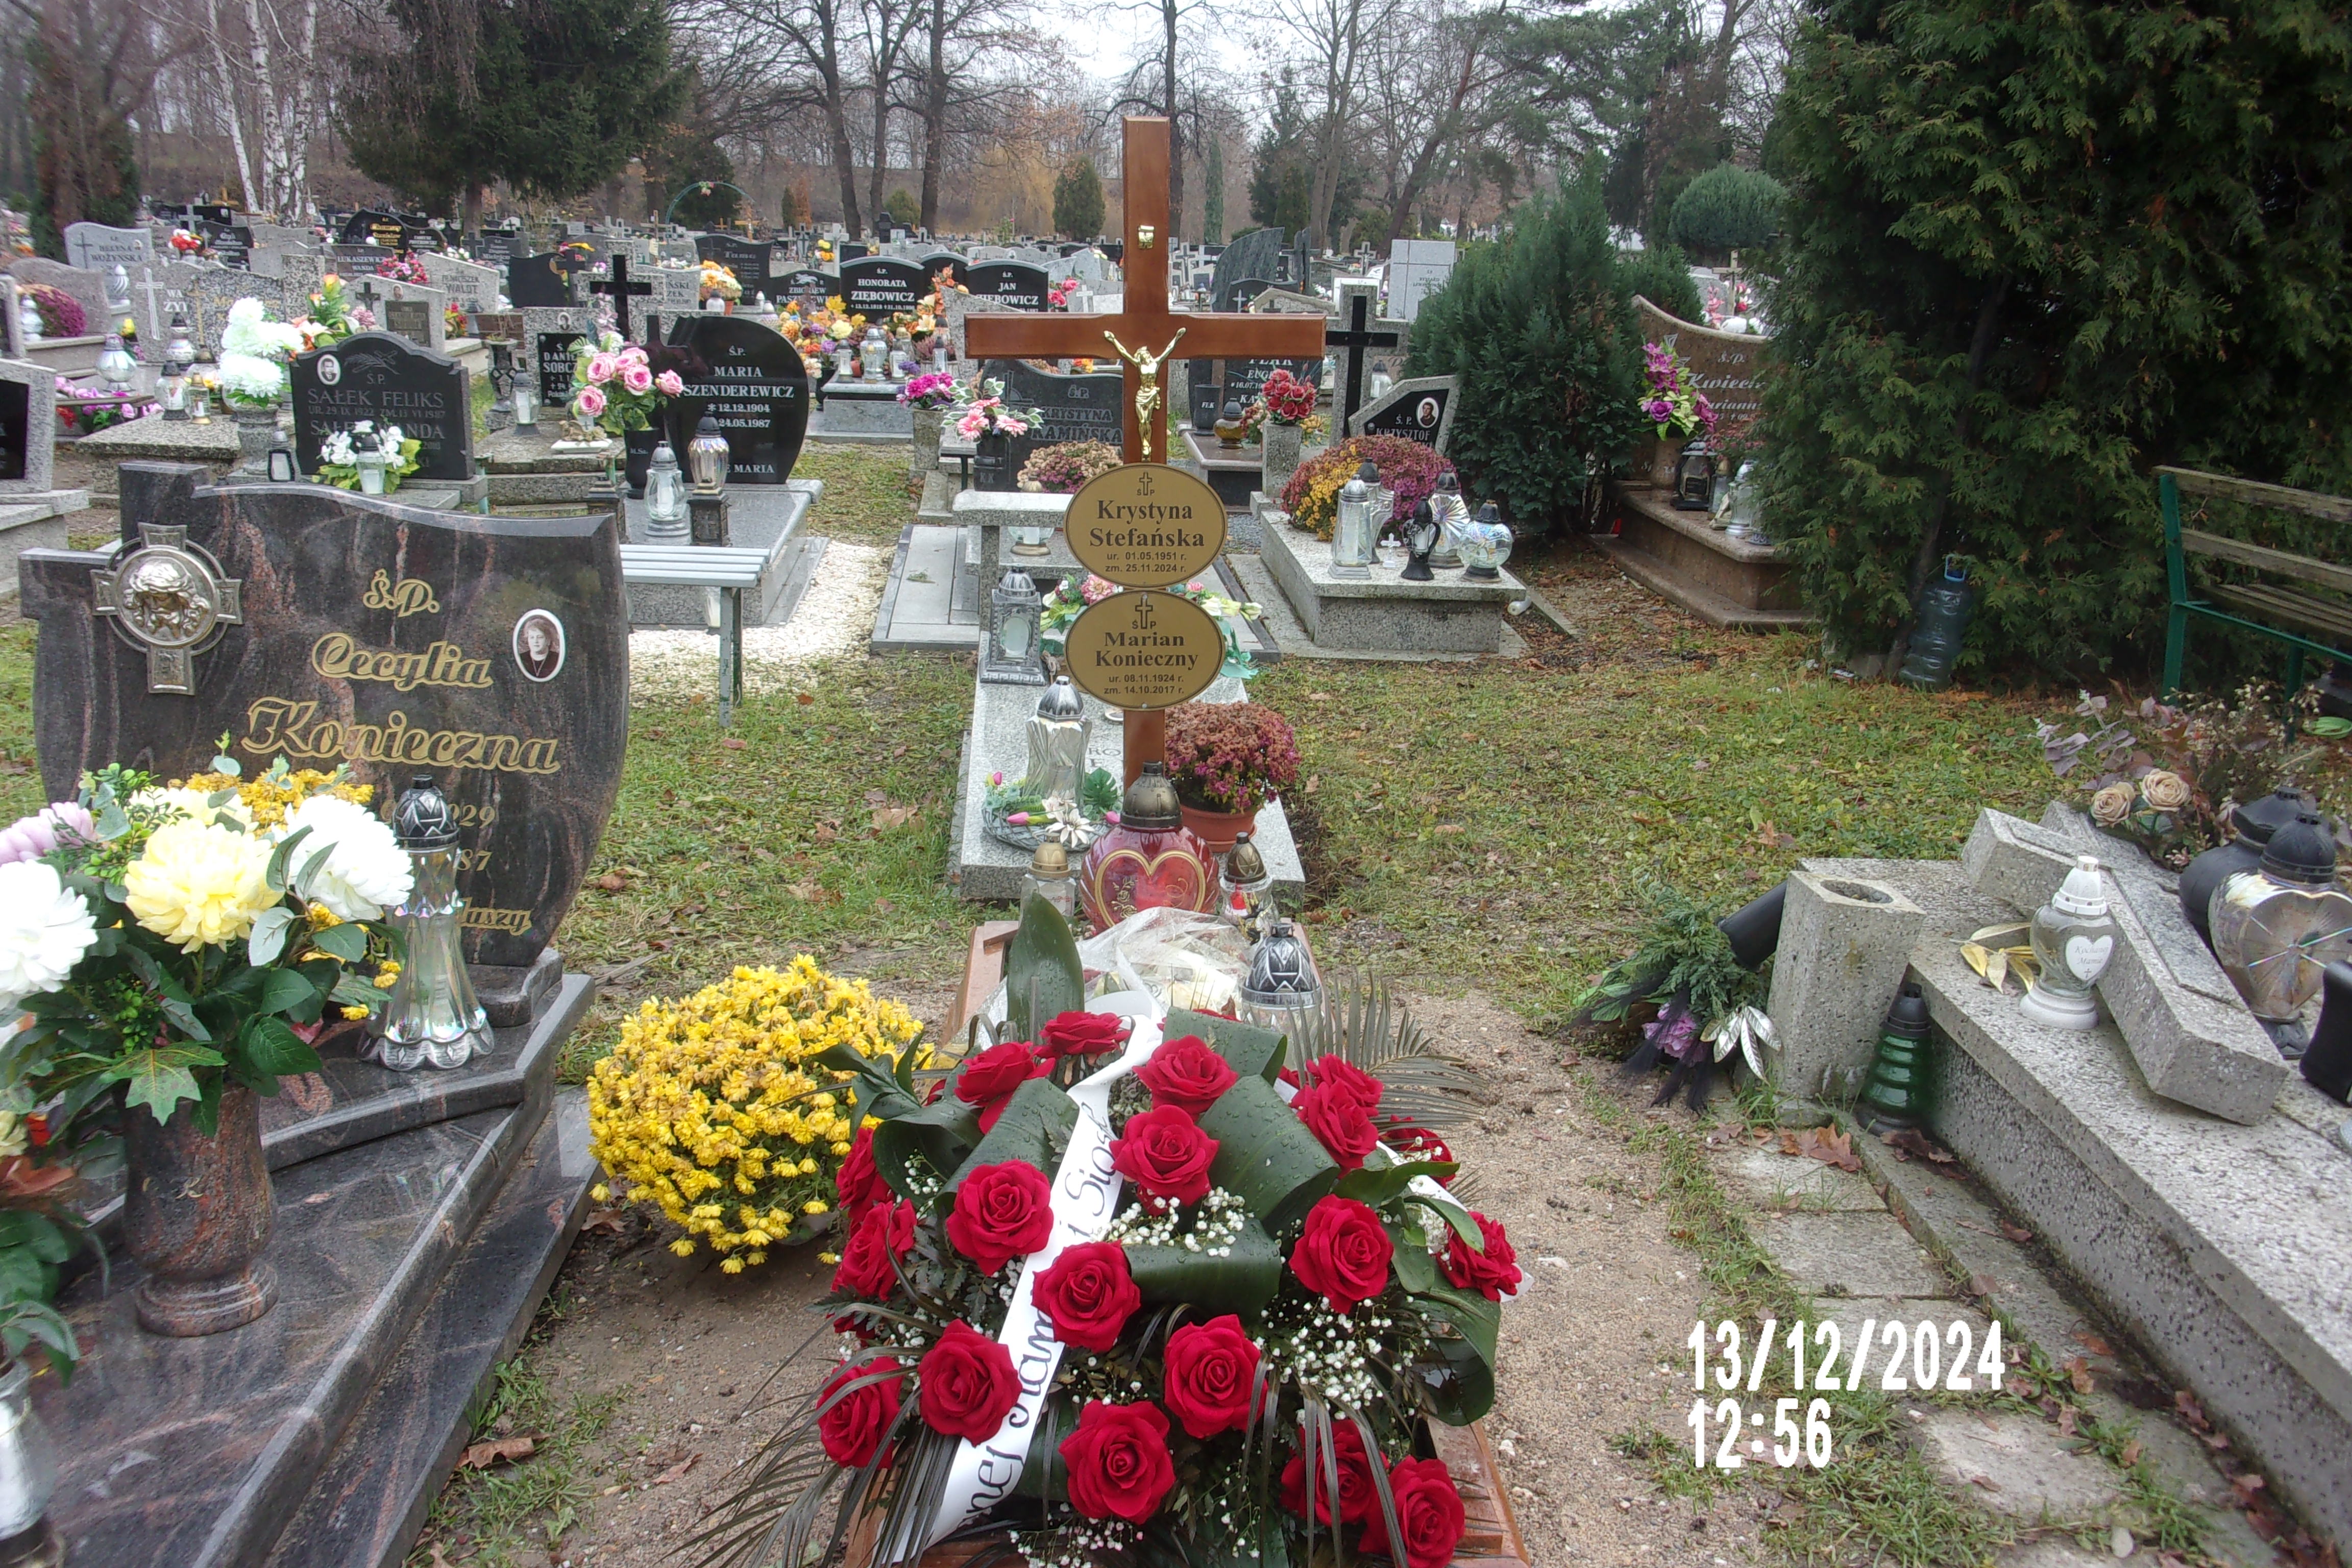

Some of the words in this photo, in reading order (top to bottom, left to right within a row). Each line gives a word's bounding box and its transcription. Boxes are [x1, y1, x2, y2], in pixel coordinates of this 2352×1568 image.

[857, 278, 907, 287] HONORATA
[998, 282, 1016, 292] JAN
[851, 291, 915, 302] ZIĘBOWICZ
[714, 366, 763, 377] MARIA
[682, 384, 794, 398] SZENDEREWICZ
[308, 388, 372, 406] SAŁEK
[382, 391, 444, 408] FELIKS
[718, 403, 770, 412] 12.12.1904
[1039, 406, 1113, 423] KRYSTYNA
[718, 419, 770, 428] 24.05.1987
[1031, 423, 1123, 444] KAMIŃSKA
[734, 464, 774, 473] MARIA
[1136, 488, 1142, 496] Ś
[1097, 500, 1192, 525] Krystyna
[1089, 527, 1205, 547] Stefańska
[1125, 551, 1177, 560] 01.05.1951
[1126, 564, 1177, 573] 25.11.2024
[363, 568, 440, 617] Ś.P.
[1132, 619, 1139, 629] Ś
[1149, 621, 1157, 629] P
[1104, 632, 1185, 647] Marian
[311, 632, 494, 692] Cecylia
[1095, 650, 1198, 671] Konieczny
[1124, 674, 1175, 683] 08.11.1924
[1124, 685, 1175, 695] 14.10.2017
[240, 696, 561, 774] Konieczna
